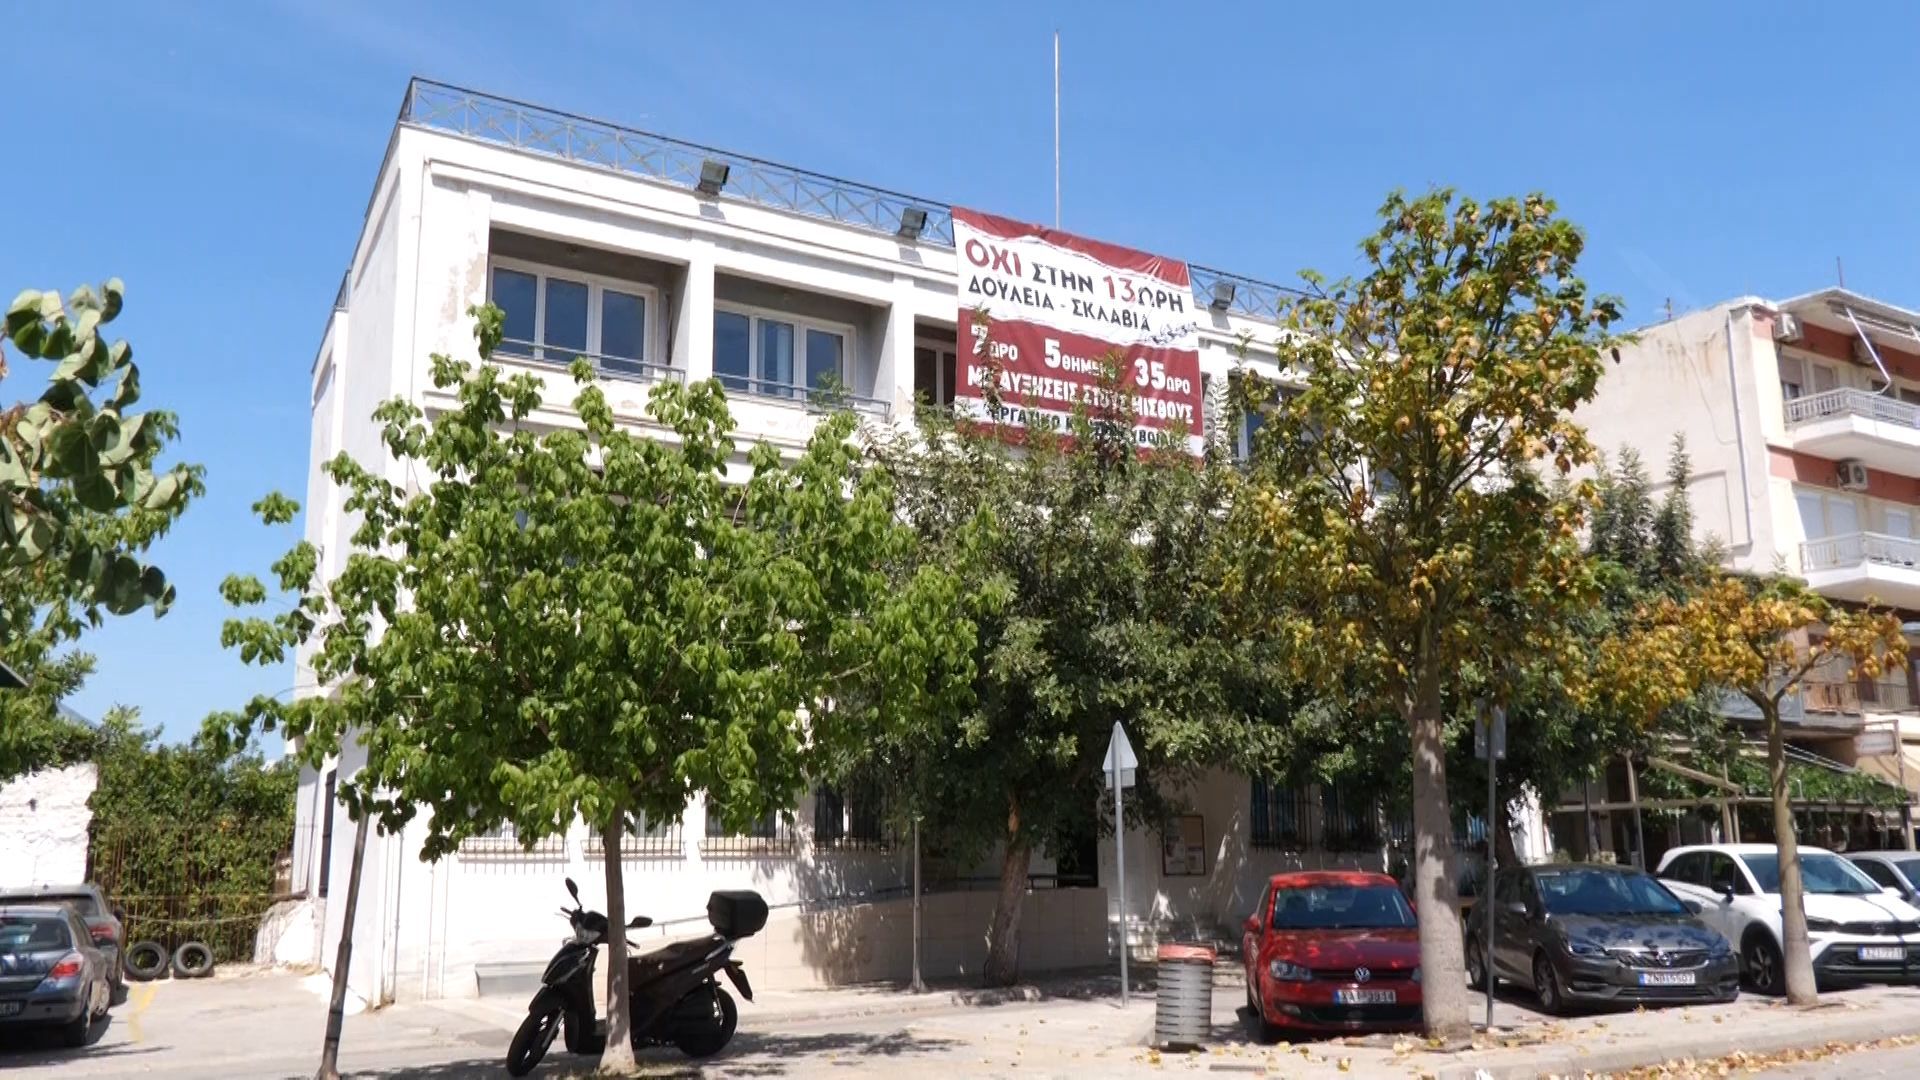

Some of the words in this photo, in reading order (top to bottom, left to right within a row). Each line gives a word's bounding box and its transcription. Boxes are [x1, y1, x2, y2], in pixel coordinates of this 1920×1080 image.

[965, 238, 1022, 277] ΟΧΙ
[1032, 261, 1094, 294] ΣΤΗΝ
[968, 275, 1054, 311] ΔΟΥΛΕΙΑ
[1072, 298, 1151, 332] ΣΚΛΑΒΙΑ
[1000, 369, 1078, 402] ΑΥΞΗΣΕΙΣ
